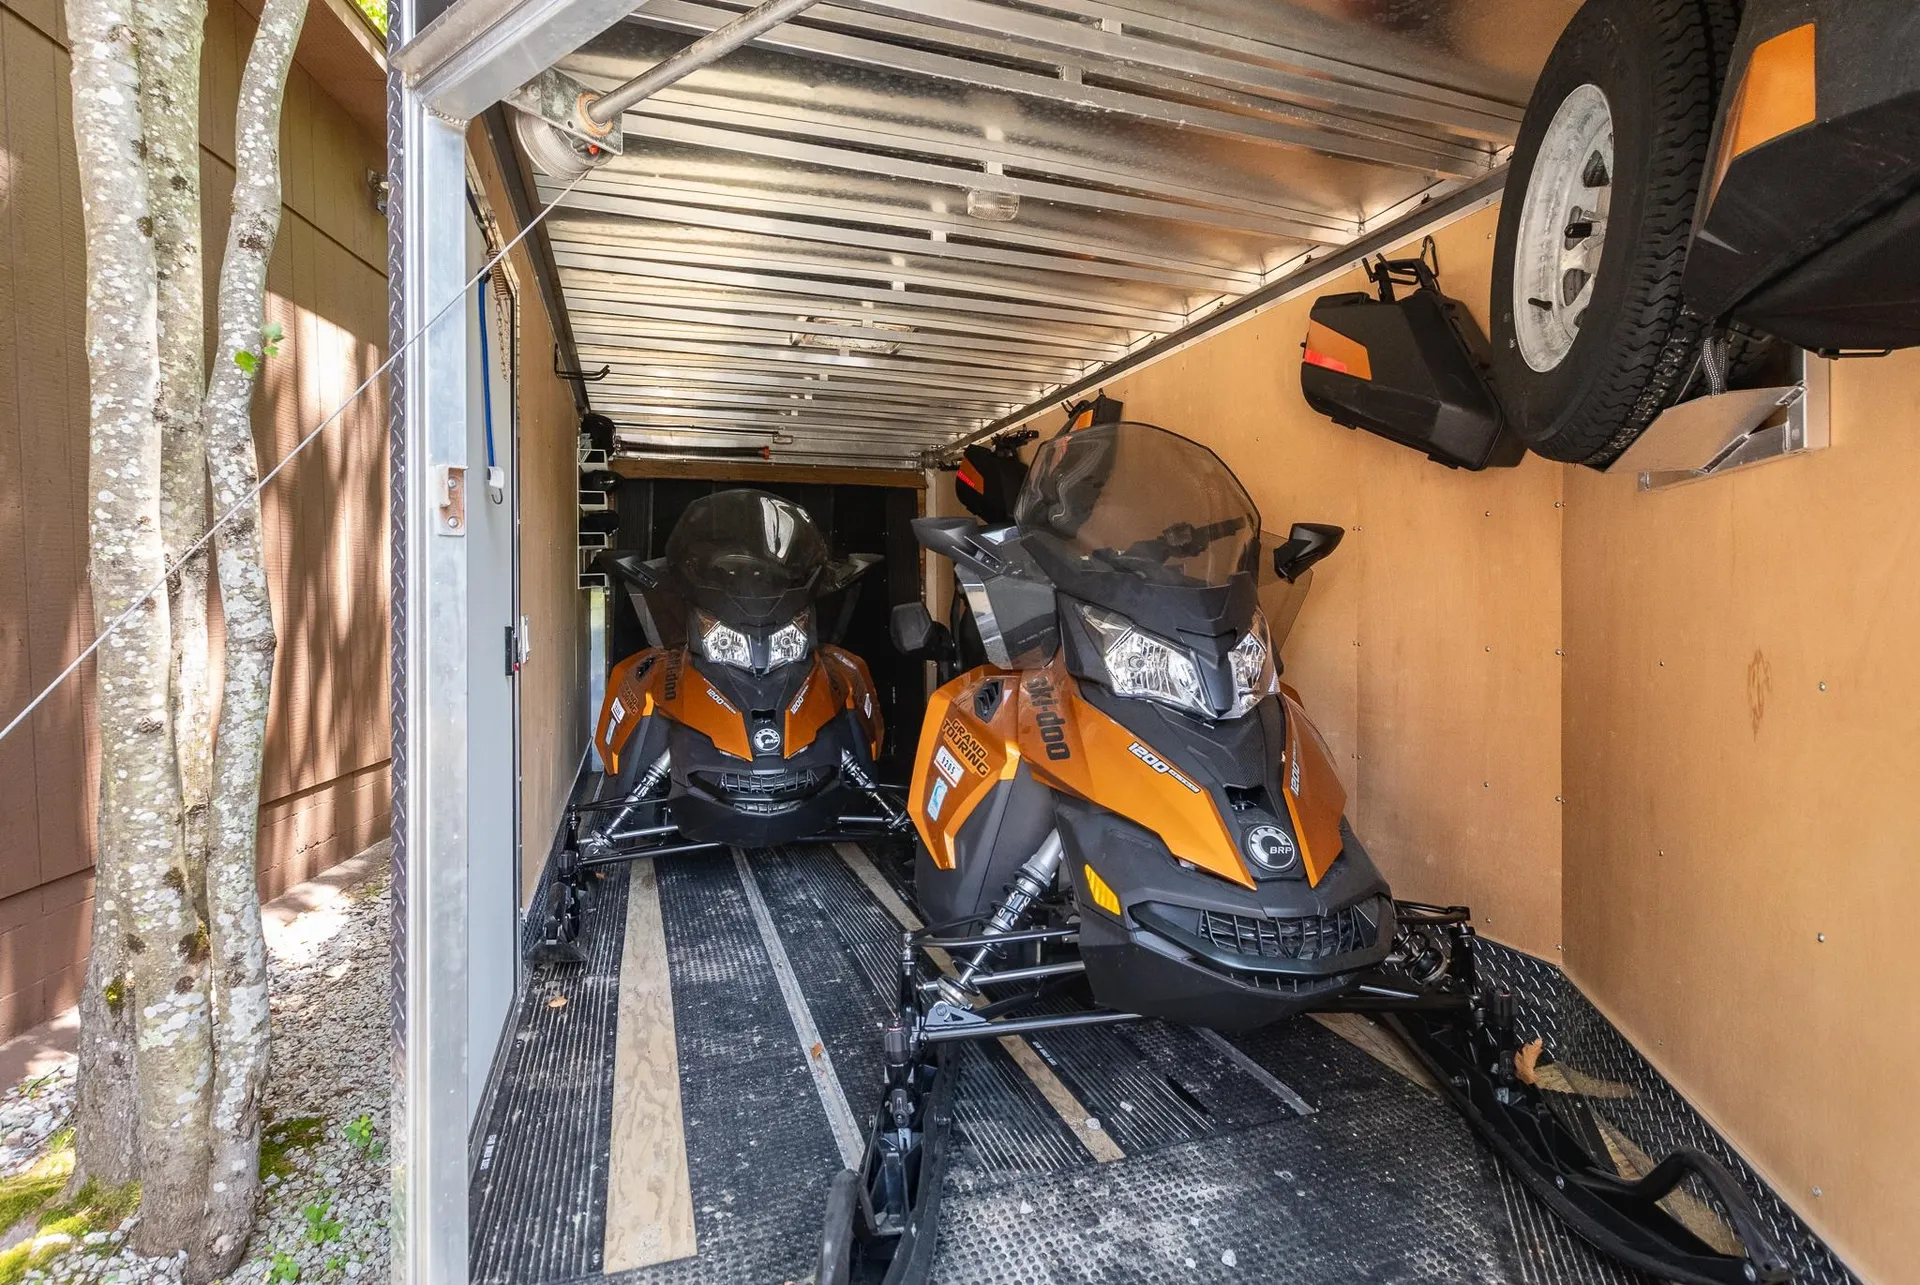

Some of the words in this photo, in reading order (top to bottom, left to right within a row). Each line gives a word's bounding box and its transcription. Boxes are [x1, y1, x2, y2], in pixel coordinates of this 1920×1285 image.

[706, 689, 724, 705] 1200
[790, 696, 804, 714] 1200
[942, 720, 989, 776] TOURING
[951, 719, 987, 759] GRAND
[1127, 741, 1171, 773] 1200
[1290, 760, 1300, 797] 1200
[1269, 846, 1292, 855] BRP
